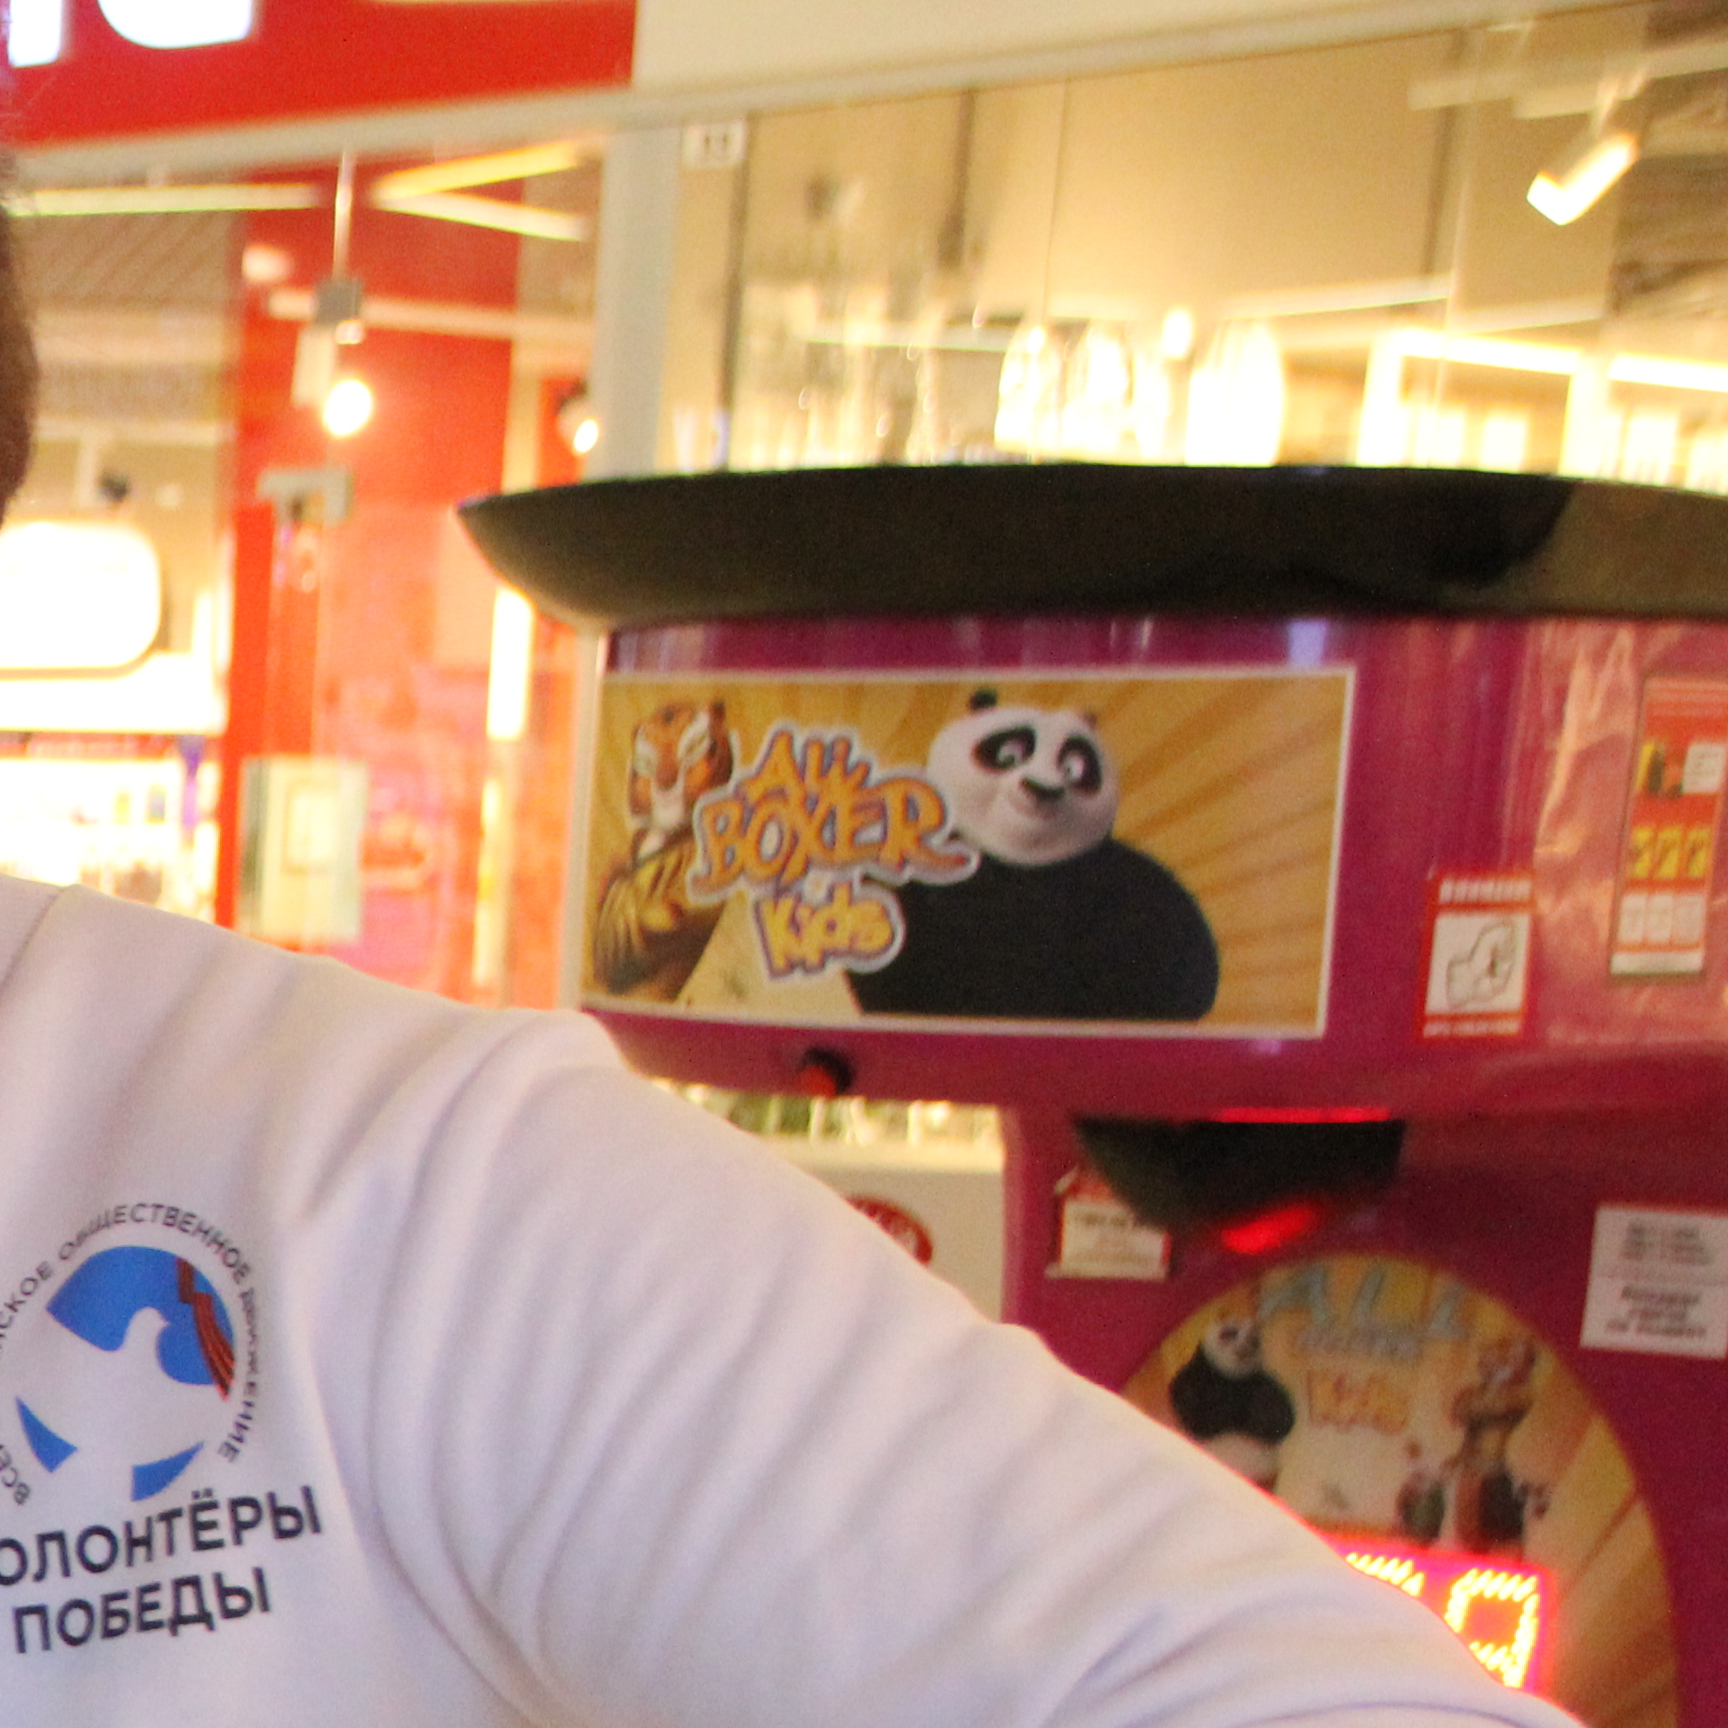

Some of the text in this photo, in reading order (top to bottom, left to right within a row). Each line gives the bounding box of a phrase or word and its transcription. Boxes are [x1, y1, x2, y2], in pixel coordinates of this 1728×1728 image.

[689, 776, 968, 890] BOXER
[58, 1202, 251, 1286] ОБЩЕСТВЕННОЕ
[12, 1566, 271, 1654] ПОБЕДЫ
